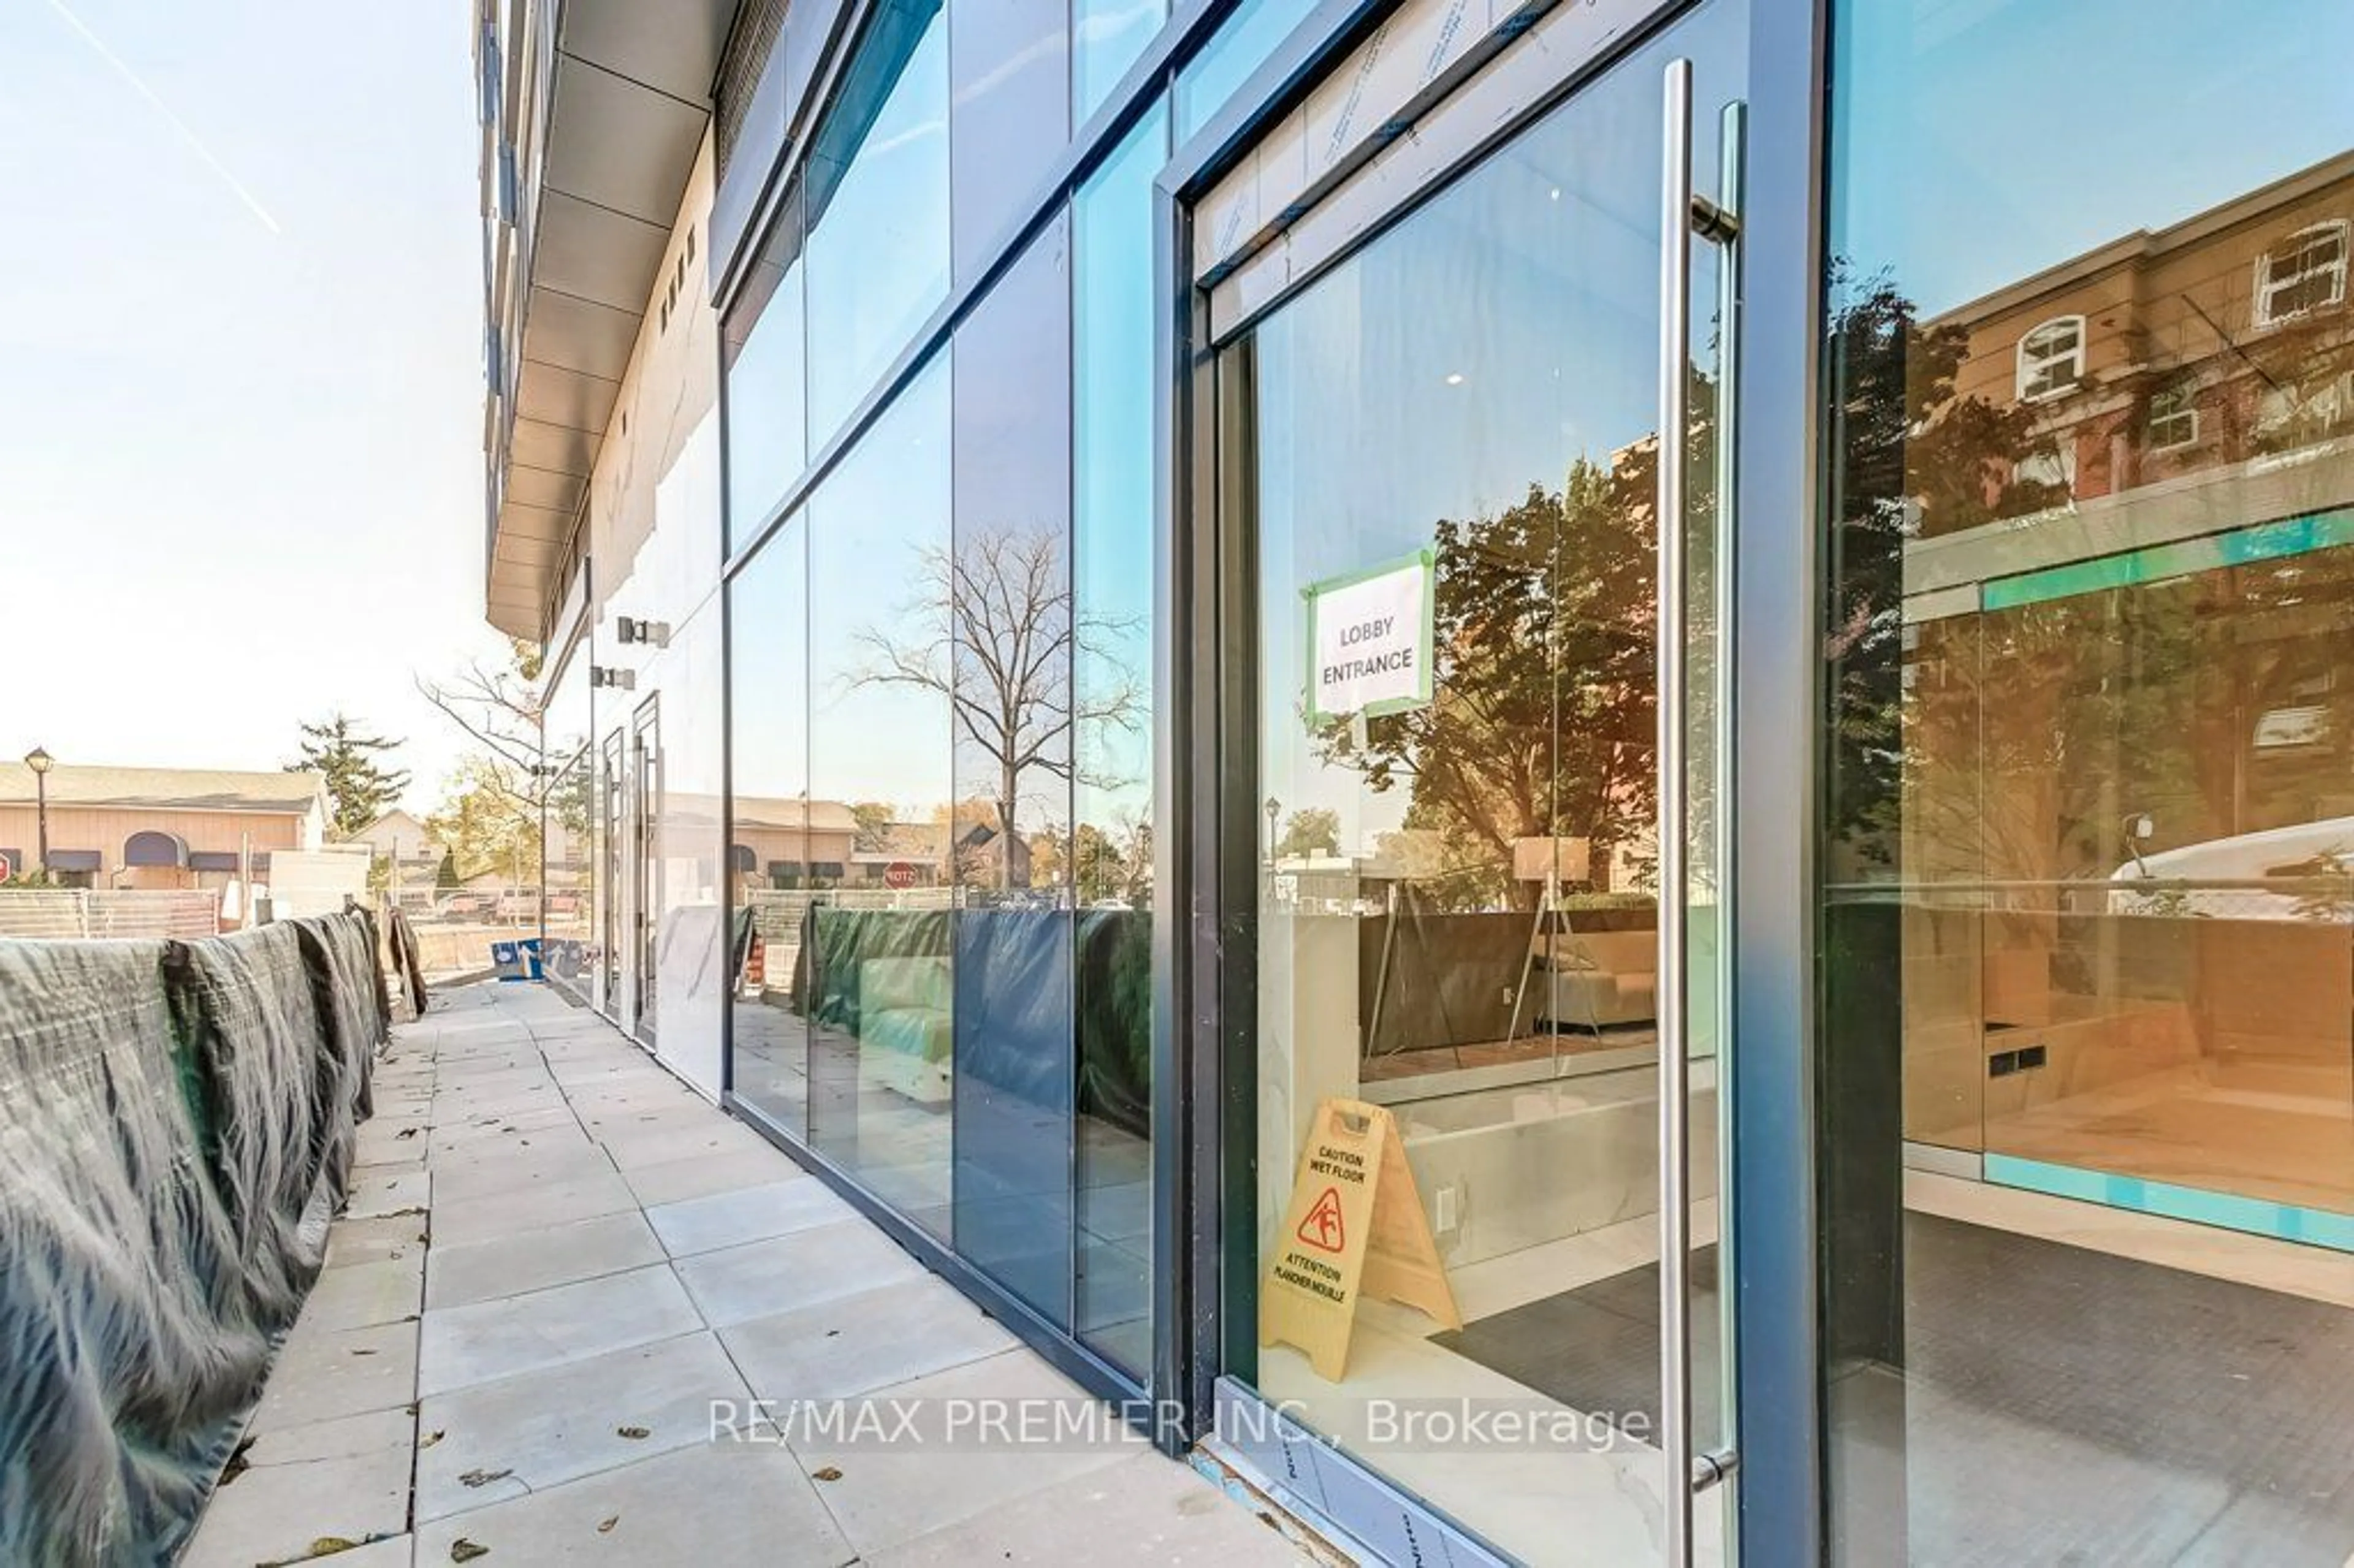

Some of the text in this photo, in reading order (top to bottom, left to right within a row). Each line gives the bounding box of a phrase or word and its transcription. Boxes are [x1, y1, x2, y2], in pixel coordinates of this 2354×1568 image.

[1340, 616, 1394, 647] LOBBY
[1324, 648, 1412, 684] ENTRANCE
[1319, 1144, 1364, 1167] CAUTION
[1310, 1158, 1366, 1184] WET FLOOR
[1274, 1266, 1311, 1288] PLANCHER
[1286, 1253, 1341, 1282] ATTENTION
